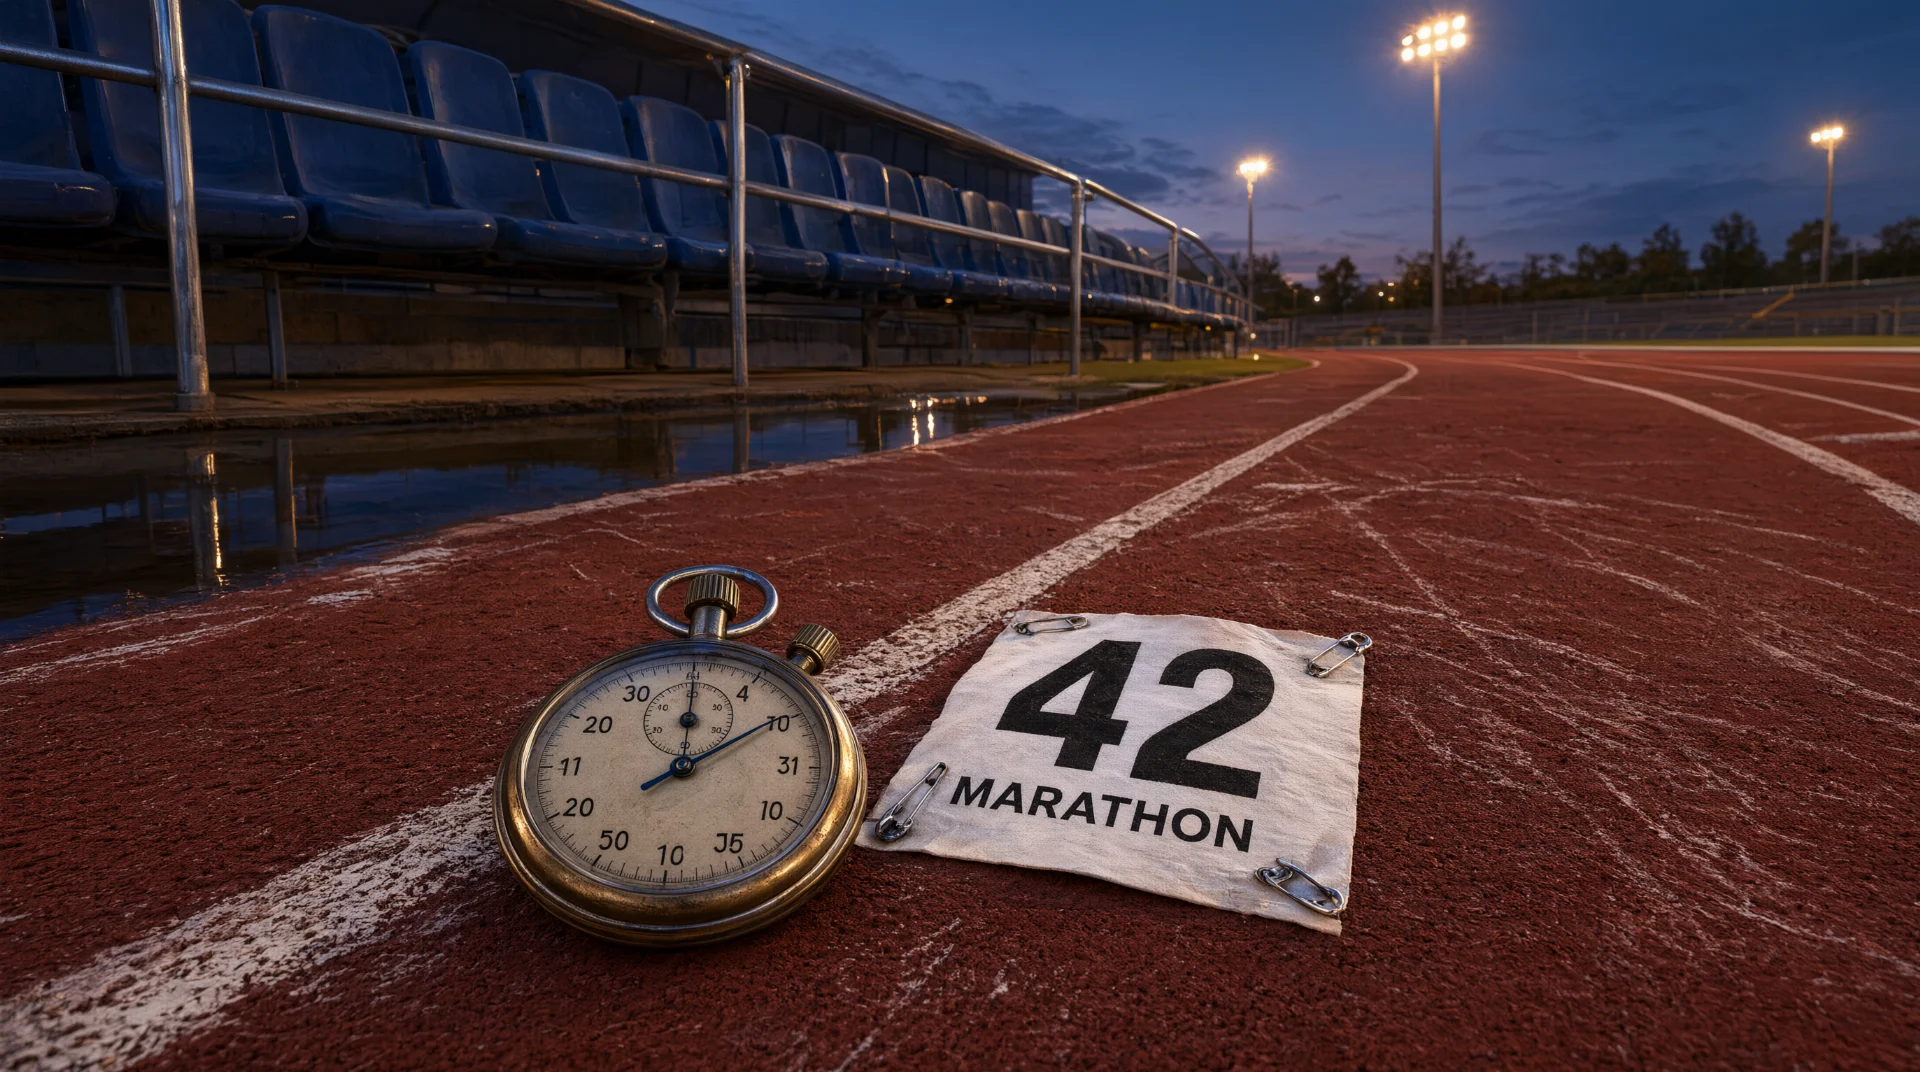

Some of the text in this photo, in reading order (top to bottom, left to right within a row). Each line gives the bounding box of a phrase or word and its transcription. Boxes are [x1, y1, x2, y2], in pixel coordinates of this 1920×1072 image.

[623, 685, 650, 703] 30
[736, 685, 750, 703] 4
[583, 716, 613, 734] 20
[996, 640, 1275, 799] 42
[561, 757, 581, 776] 11
[777, 757, 798, 776] 31
[563, 798, 594, 817] 20
[761, 800, 783, 821] 10
[950, 776, 1253, 853] MARATHON
[599, 830, 629, 850] 50
[657, 845, 684, 866] 10
